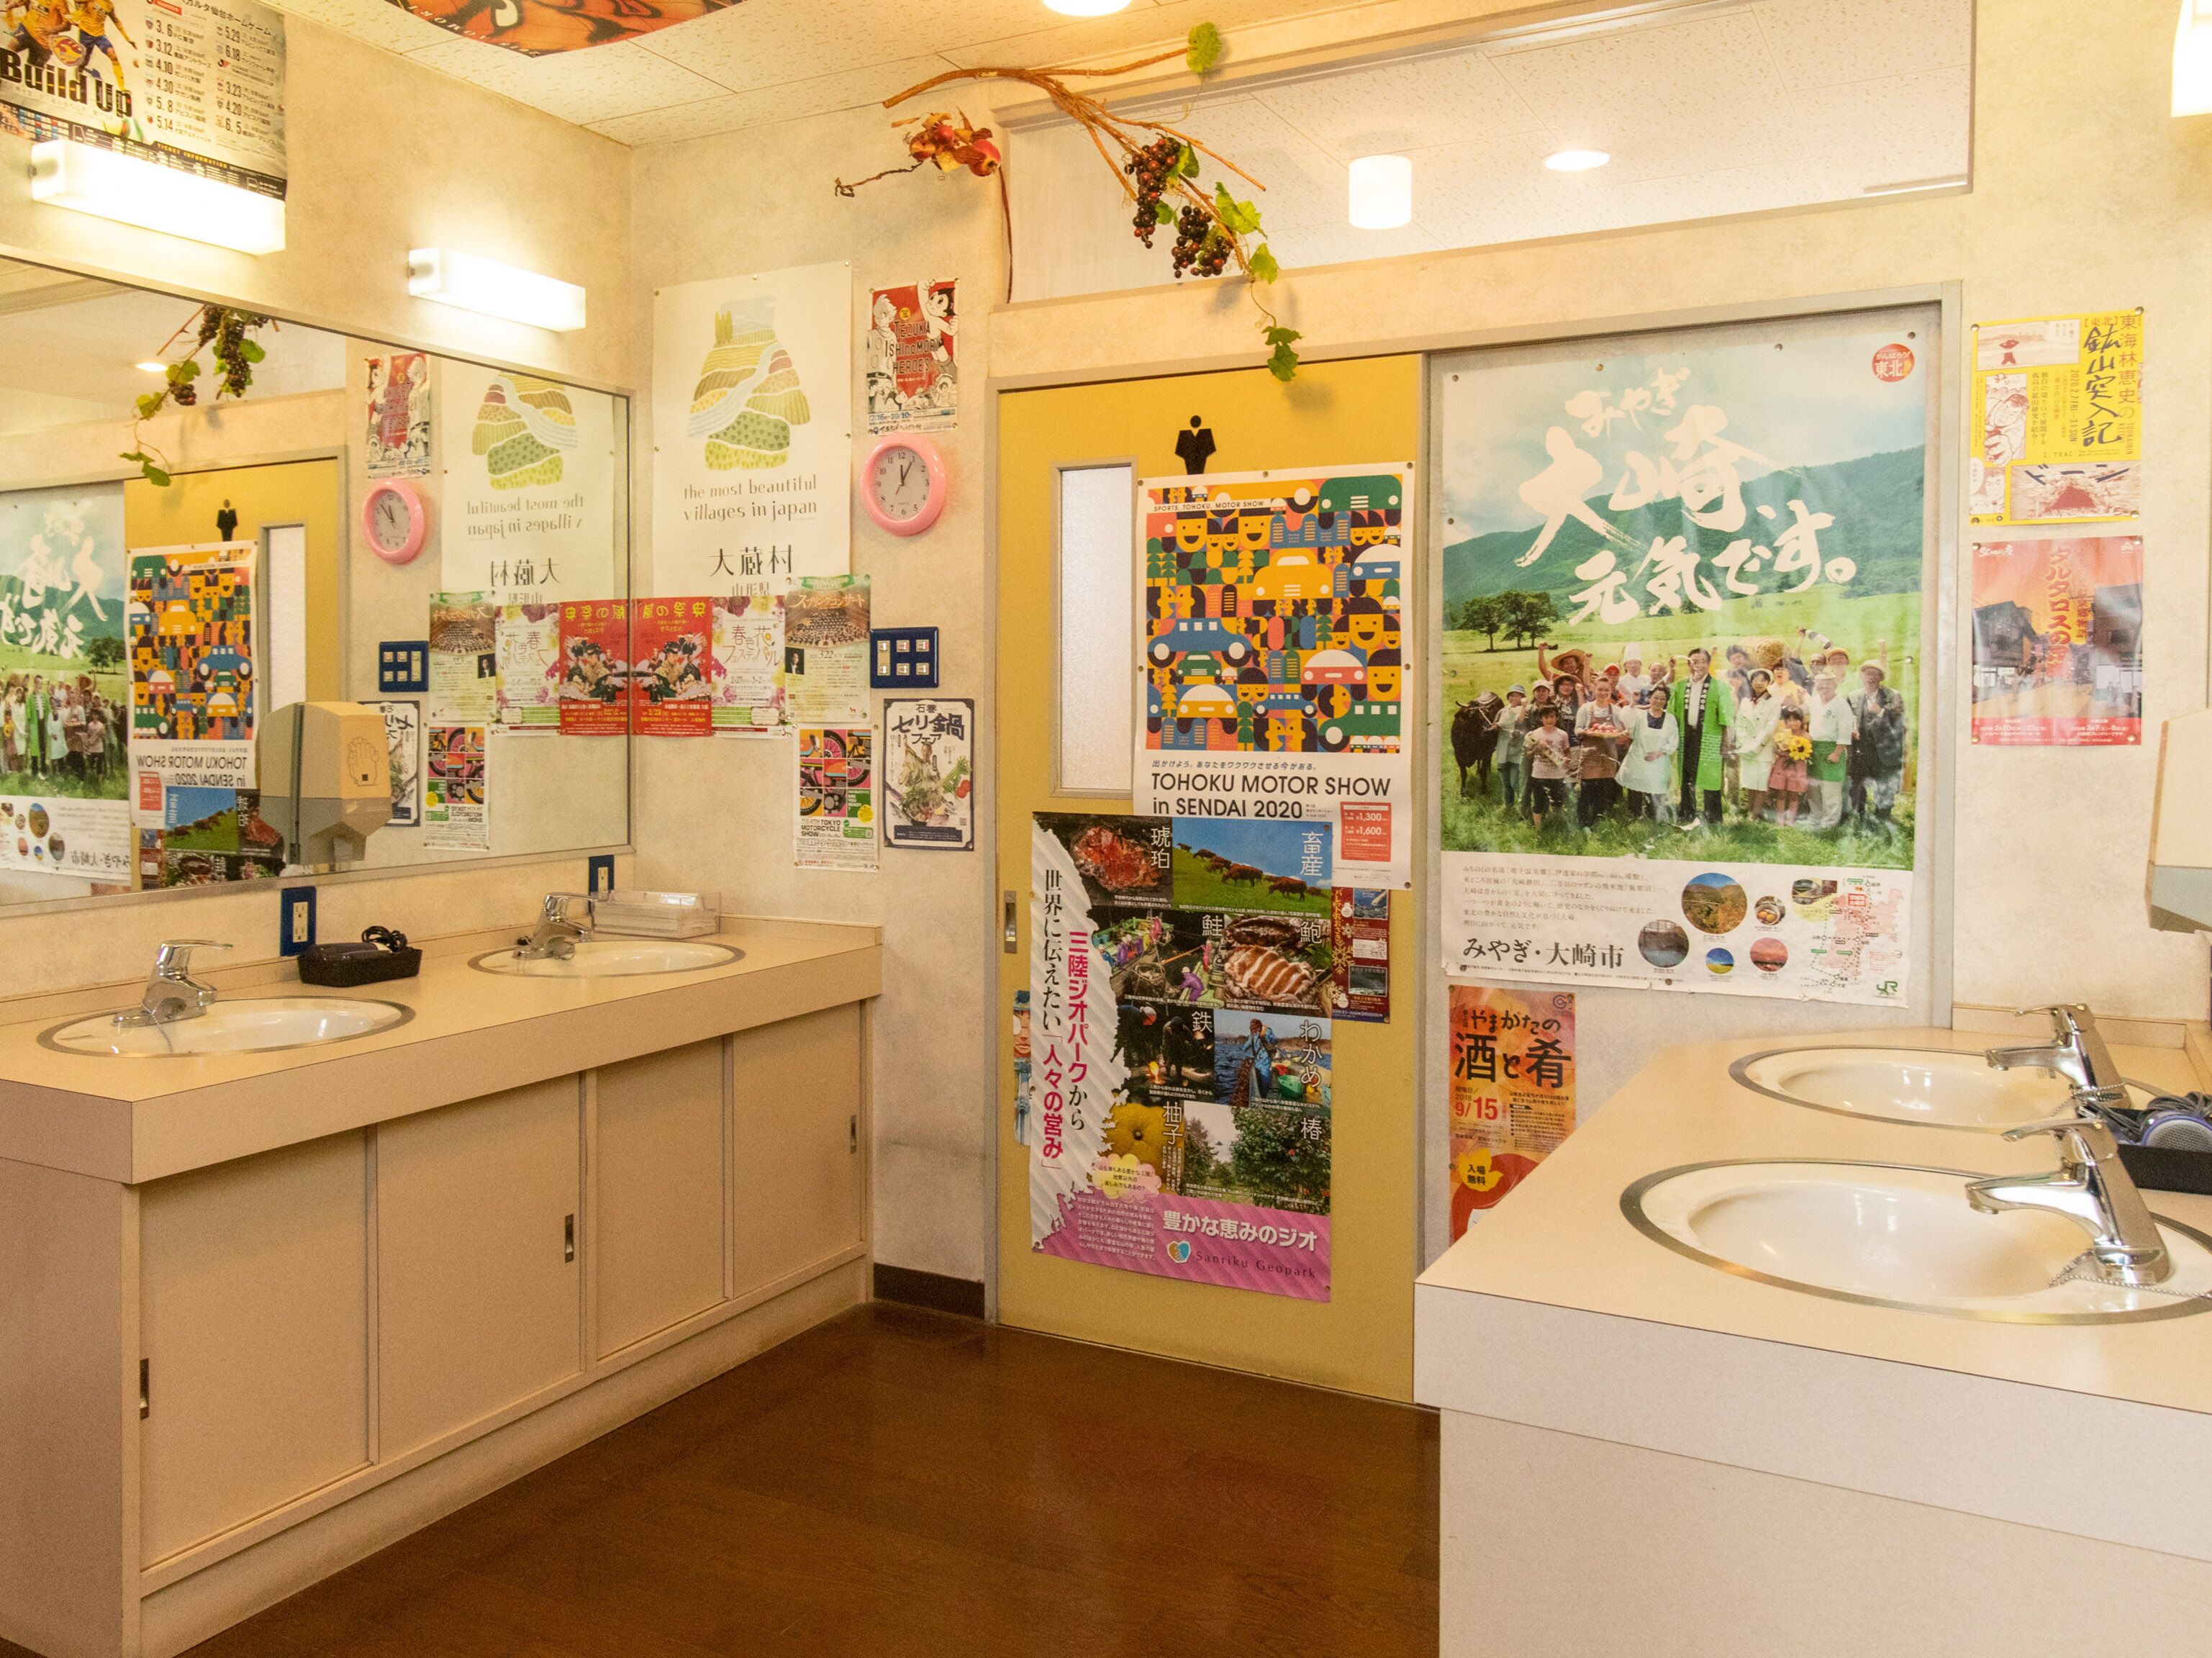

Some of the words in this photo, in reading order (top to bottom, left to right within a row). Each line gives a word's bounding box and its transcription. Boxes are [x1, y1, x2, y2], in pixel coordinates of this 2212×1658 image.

[0, 47, 88, 105] Build
[95, 79, 132, 118] Up
[894, 321, 930, 338] TEZUKA
[893, 358, 930, 374] HEROES
[1875, 361, 1903, 379] 東北
[2118, 314, 2139, 420] 東海林恵史の
[1565, 367, 1691, 436] みやぎ
[684, 484, 707, 500] the
[710, 479, 743, 497] most
[748, 474, 817, 495] beautiful
[684, 502, 745, 522] villages
[751, 502, 766, 518] in
[771, 499, 817, 522] japan
[708, 545, 794, 576] 大蔵村
[1569, 499, 1857, 627] 元気です。
[732, 582, 771, 597] 山形県
[791, 593, 864, 608] スプリングコンサート
[722, 645, 784, 666] フェスティバル
[916, 704, 937, 713] 石巻
[892, 713, 964, 740] セリ鍋
[912, 734, 942, 744] フェア
[1151, 773, 1235, 792] TOHOKU
[1241, 774, 1318, 794] MOTOR
[1325, 777, 1391, 796] SHOW
[1153, 797, 1169, 813] in
[1175, 798, 1246, 817] SENDAI
[1254, 800, 1302, 818] 2020
[1151, 826, 1171, 869] 琥珀
[1300, 831, 1323, 876] 畜産
[1202, 915, 1223, 936] 鮭
[1300, 922, 1322, 944] 鮑
[1464, 938, 1623, 969] みやぎ・大崎市
[1877, 981, 1898, 992] JR
[1041, 869, 1063, 1169] 世界に伝えたい「人々の営み」
[1067, 931, 1089, 1131] 三陸ジオパークから
[1192, 1011, 1212, 1033] 鉄
[1471, 1010, 1561, 1035] やまがたの
[1300, 1020, 1323, 1088] わかめ
[1455, 1032, 1572, 1088] 酒と肴
[1455, 1097, 1498, 1120] 9/15
[1163, 1101, 1184, 1146] 柚子
[1301, 1117, 1323, 1141] 椿
[1467, 1164, 1486, 1175] 入場
[1467, 1174, 1486, 1186] 無料
[1163, 1210, 1318, 1251] 豊かな恵みのジオ
[1196, 1251, 1248, 1269] Sanriku
[1256, 1259, 1316, 1279] Geopark
